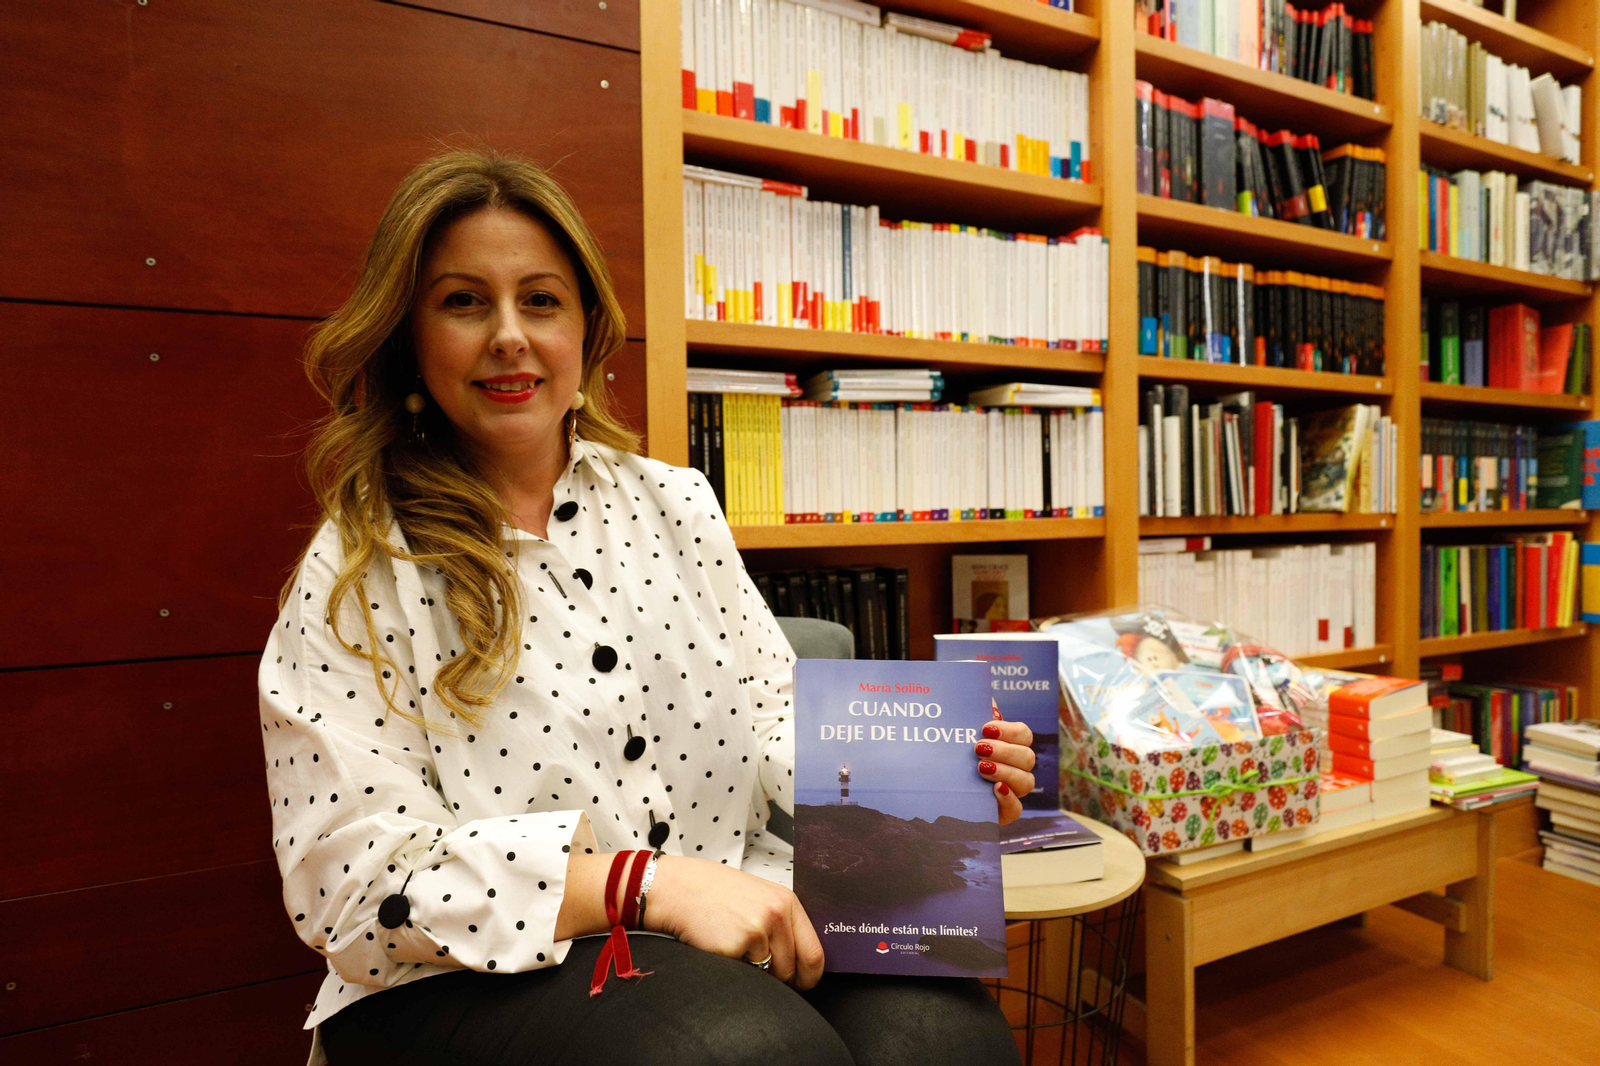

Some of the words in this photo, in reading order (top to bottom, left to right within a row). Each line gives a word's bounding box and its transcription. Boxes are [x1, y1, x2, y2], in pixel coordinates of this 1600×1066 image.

[991, 665, 1029, 676] ANDO
[858, 682, 892, 693] María
[895, 682, 930, 694] Soliño
[991, 680, 1000, 690] E
[1003, 680, 1050, 690] LLOVER
[848, 701, 942, 718] CUANDO
[820, 724, 863, 743] DEJE
[870, 725, 896, 741] DE
[903, 726, 977, 744] LLOVER
[824, 922, 856, 935] ¿Sabes
[858, 923, 889, 934] dónde
[892, 924, 919, 935] están
[922, 926, 937, 936] tus
[939, 925, 979, 937] límites?
[890, 942, 914, 951] Círculo
[915, 944, 930, 953] Rojo
